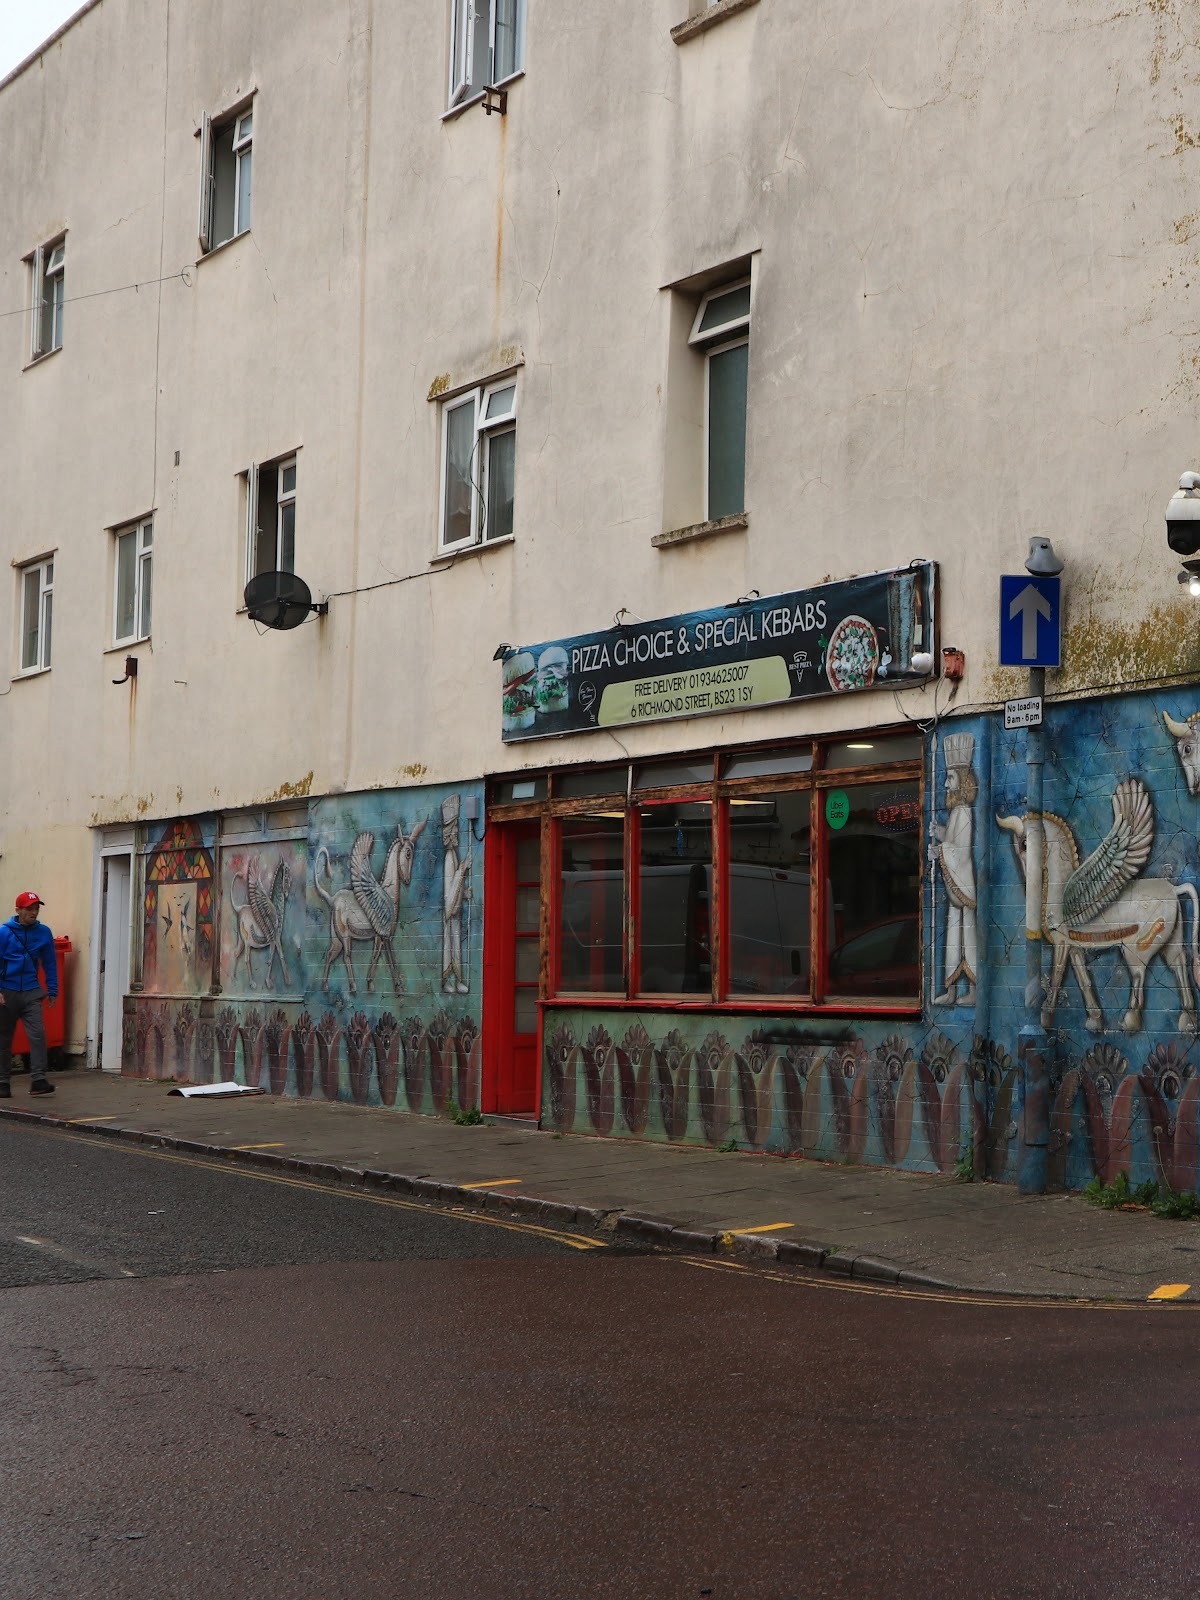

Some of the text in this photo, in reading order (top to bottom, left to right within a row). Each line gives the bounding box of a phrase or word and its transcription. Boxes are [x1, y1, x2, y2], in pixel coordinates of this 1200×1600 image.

[572, 599, 827, 674] PIZZA CHOICE & SPECIAL KEBABS
[634, 665, 749, 698] FREE DELIVERY 01934625007
[631, 704, 637, 718] 6
[638, 697, 683, 717] RICHMOND
[685, 692, 713, 710] STREET,
[715, 688, 735, 706] BS23
[1007, 702, 1040, 712] No loading
[1007, 716, 1021, 724] 9am
[830, 801, 844, 809] Uber
[830, 810, 844, 819] Eats
